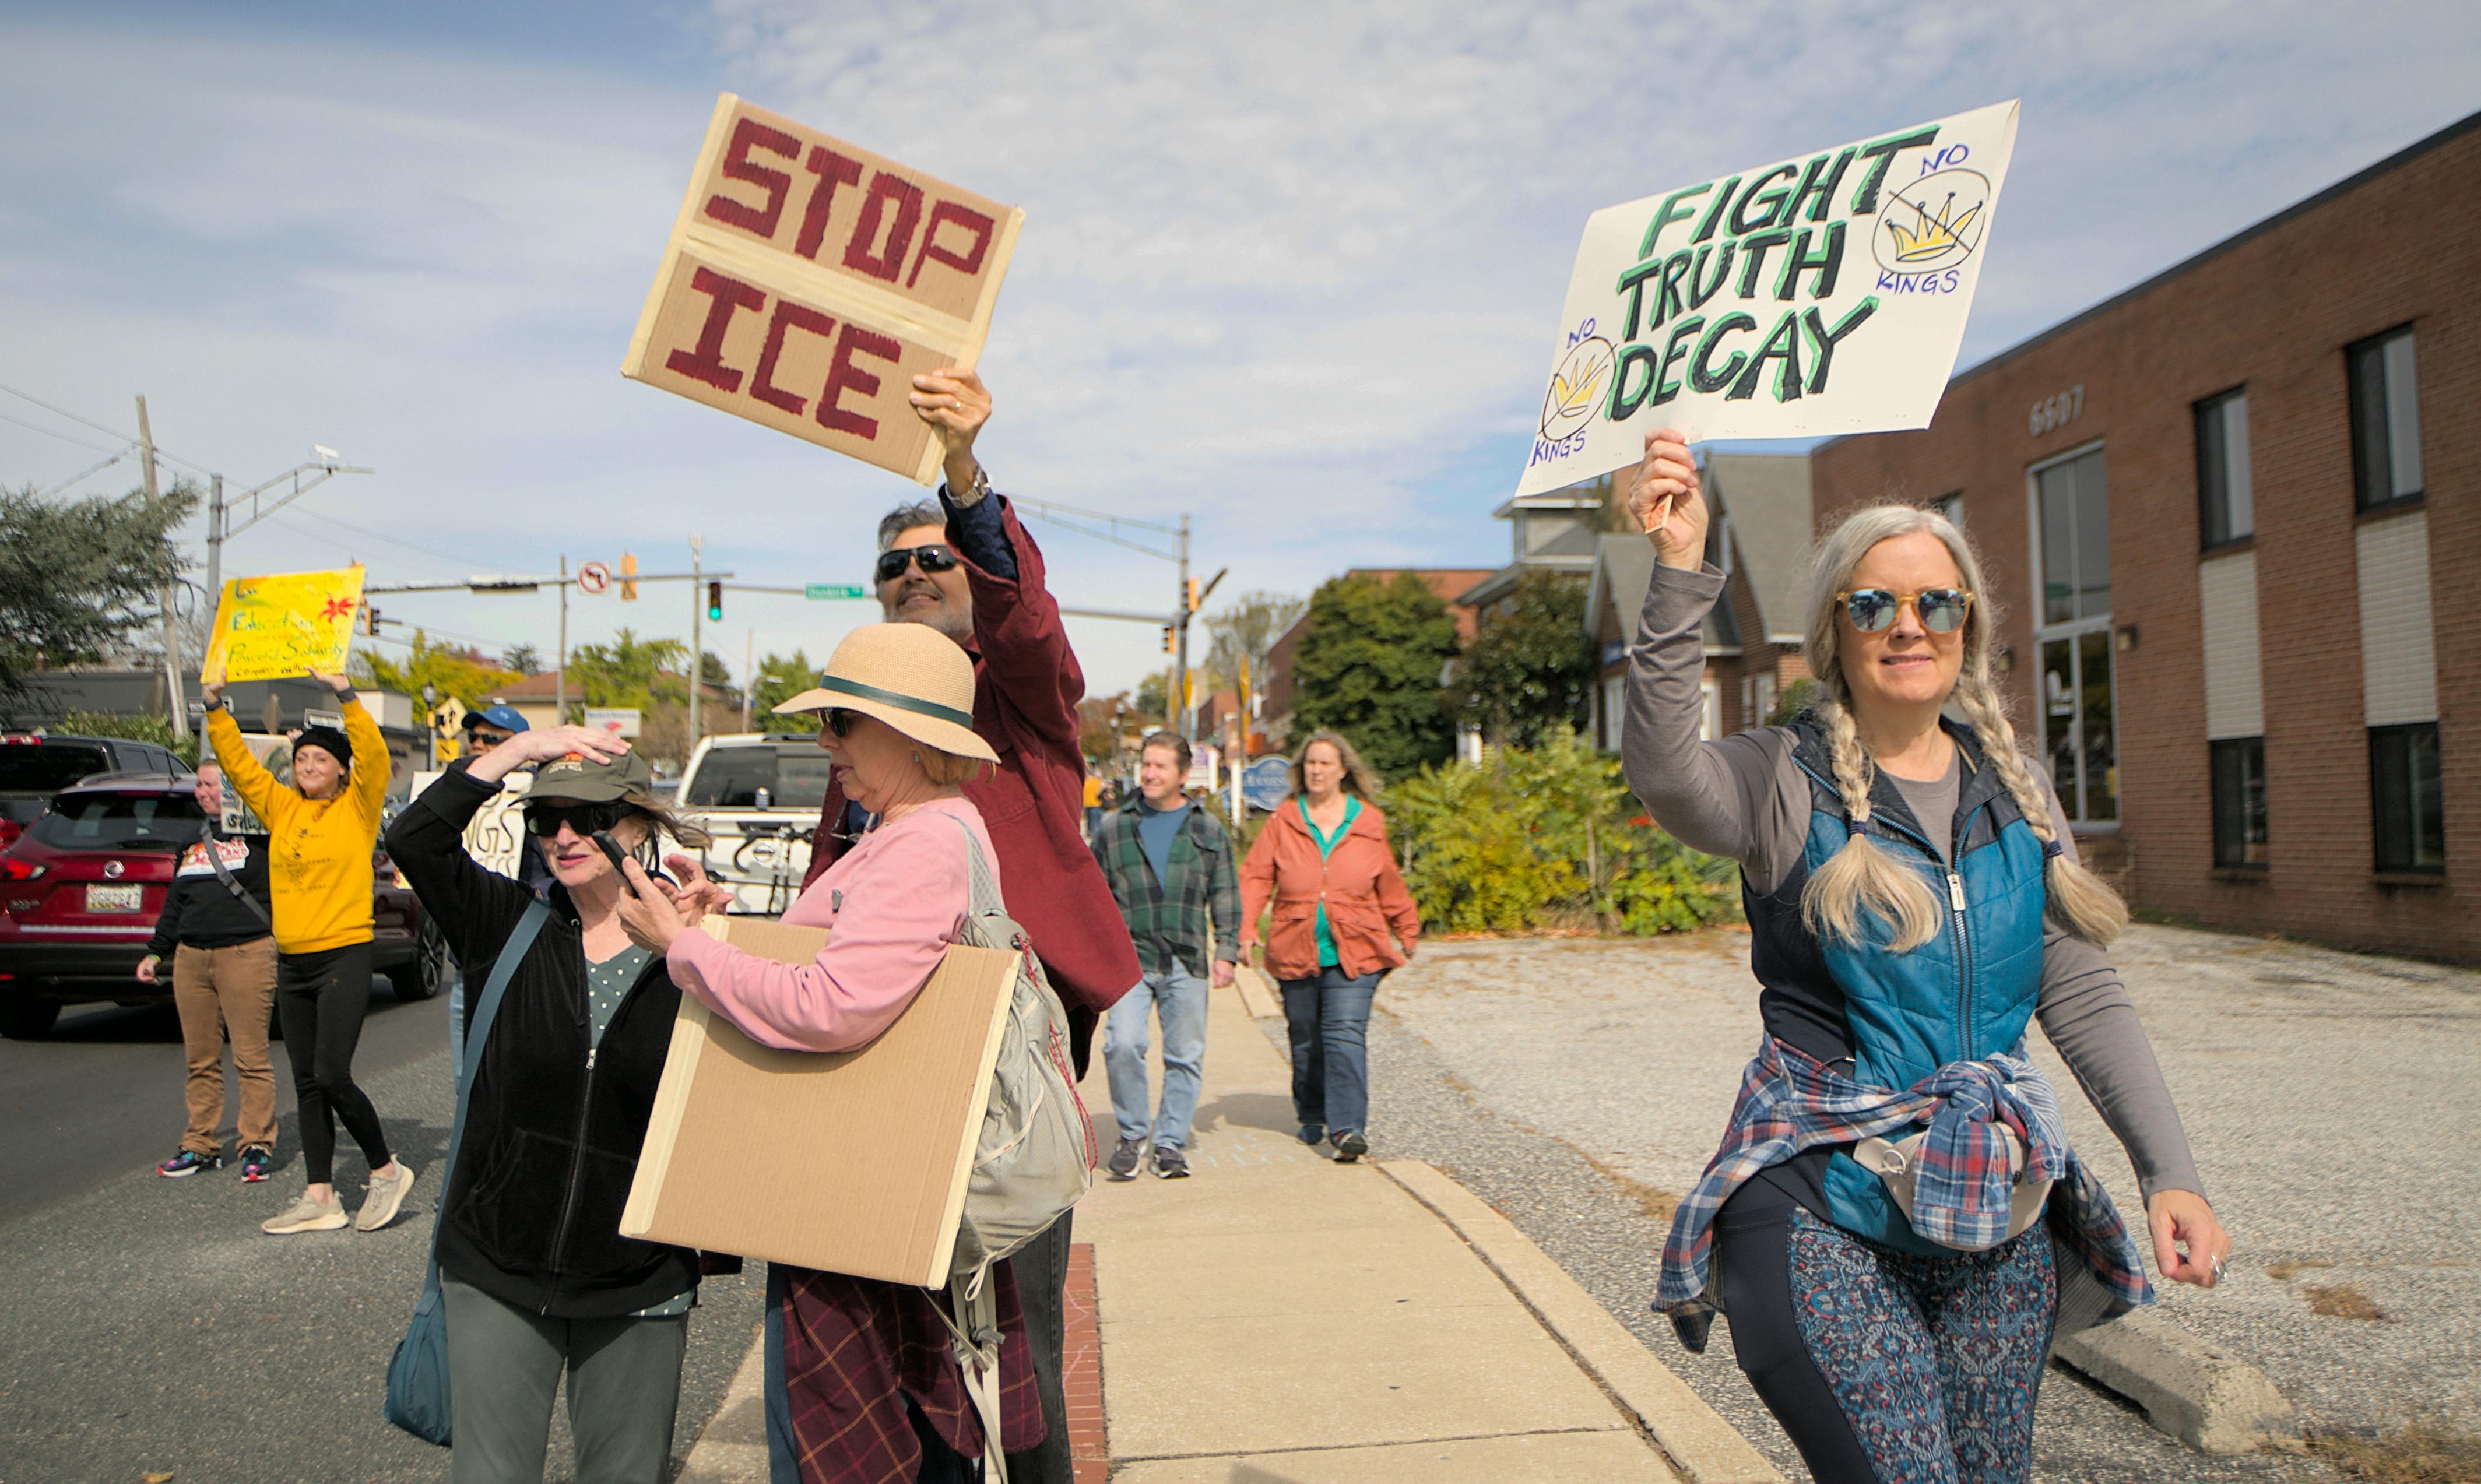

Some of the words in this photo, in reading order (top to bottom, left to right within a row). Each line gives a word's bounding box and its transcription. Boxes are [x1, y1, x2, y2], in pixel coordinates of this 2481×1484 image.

[704, 116, 995, 289] STOP
[1639, 124, 1941, 260] FIGHT
[1920, 143, 1970, 177] NO
[1566, 318, 1596, 349] NO
[1617, 220, 1847, 342] TRUTH
[1875, 268, 1960, 296] KINGS
[665, 266, 902, 441] ICE
[1604, 296, 1880, 422] DECAY
[1530, 430, 1586, 467] KINGS
